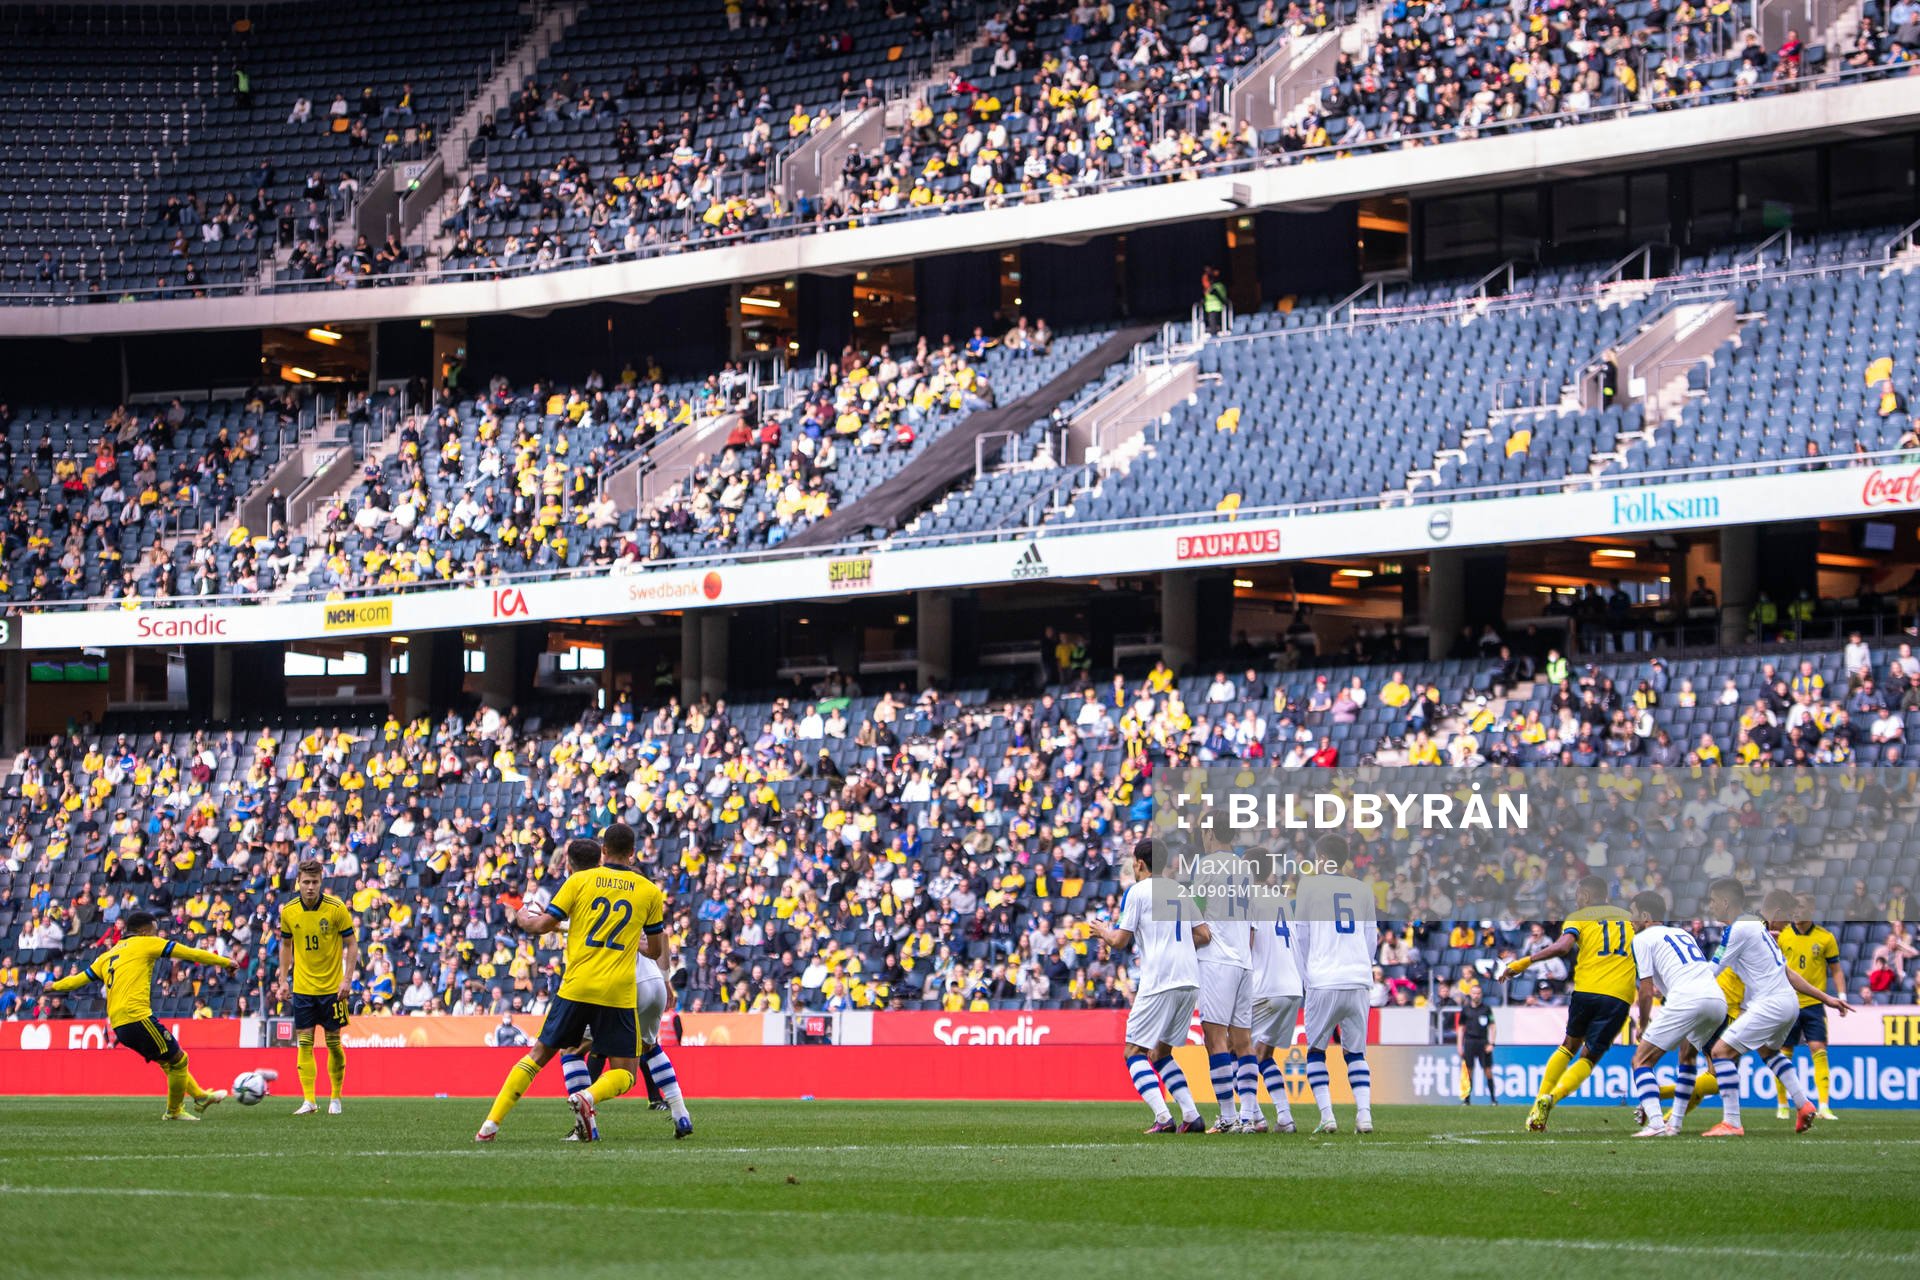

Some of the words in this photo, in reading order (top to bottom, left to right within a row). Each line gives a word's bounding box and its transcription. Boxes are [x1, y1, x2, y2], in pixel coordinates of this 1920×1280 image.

[1612, 493, 1720, 525] Folksam
[1177, 530, 1279, 558] BAUHAUS
[829, 559, 872, 581] SPORT
[493, 588, 529, 618] ICA
[628, 580, 698, 600] Swedbank
[137, 613, 227, 638] Scandic
[585, 896, 633, 951] 22
[1167, 900, 1182, 942] 7
[1275, 906, 1290, 948] 4
[1333, 892, 1356, 934] 6
[305, 935, 319, 951] 19
[1597, 919, 1629, 957] 11
[1663, 934, 1707, 965] 18
[1799, 954, 1807, 969] 8
[332, 1001, 345, 1019] 19
[933, 1016, 1051, 1045] Scandic
